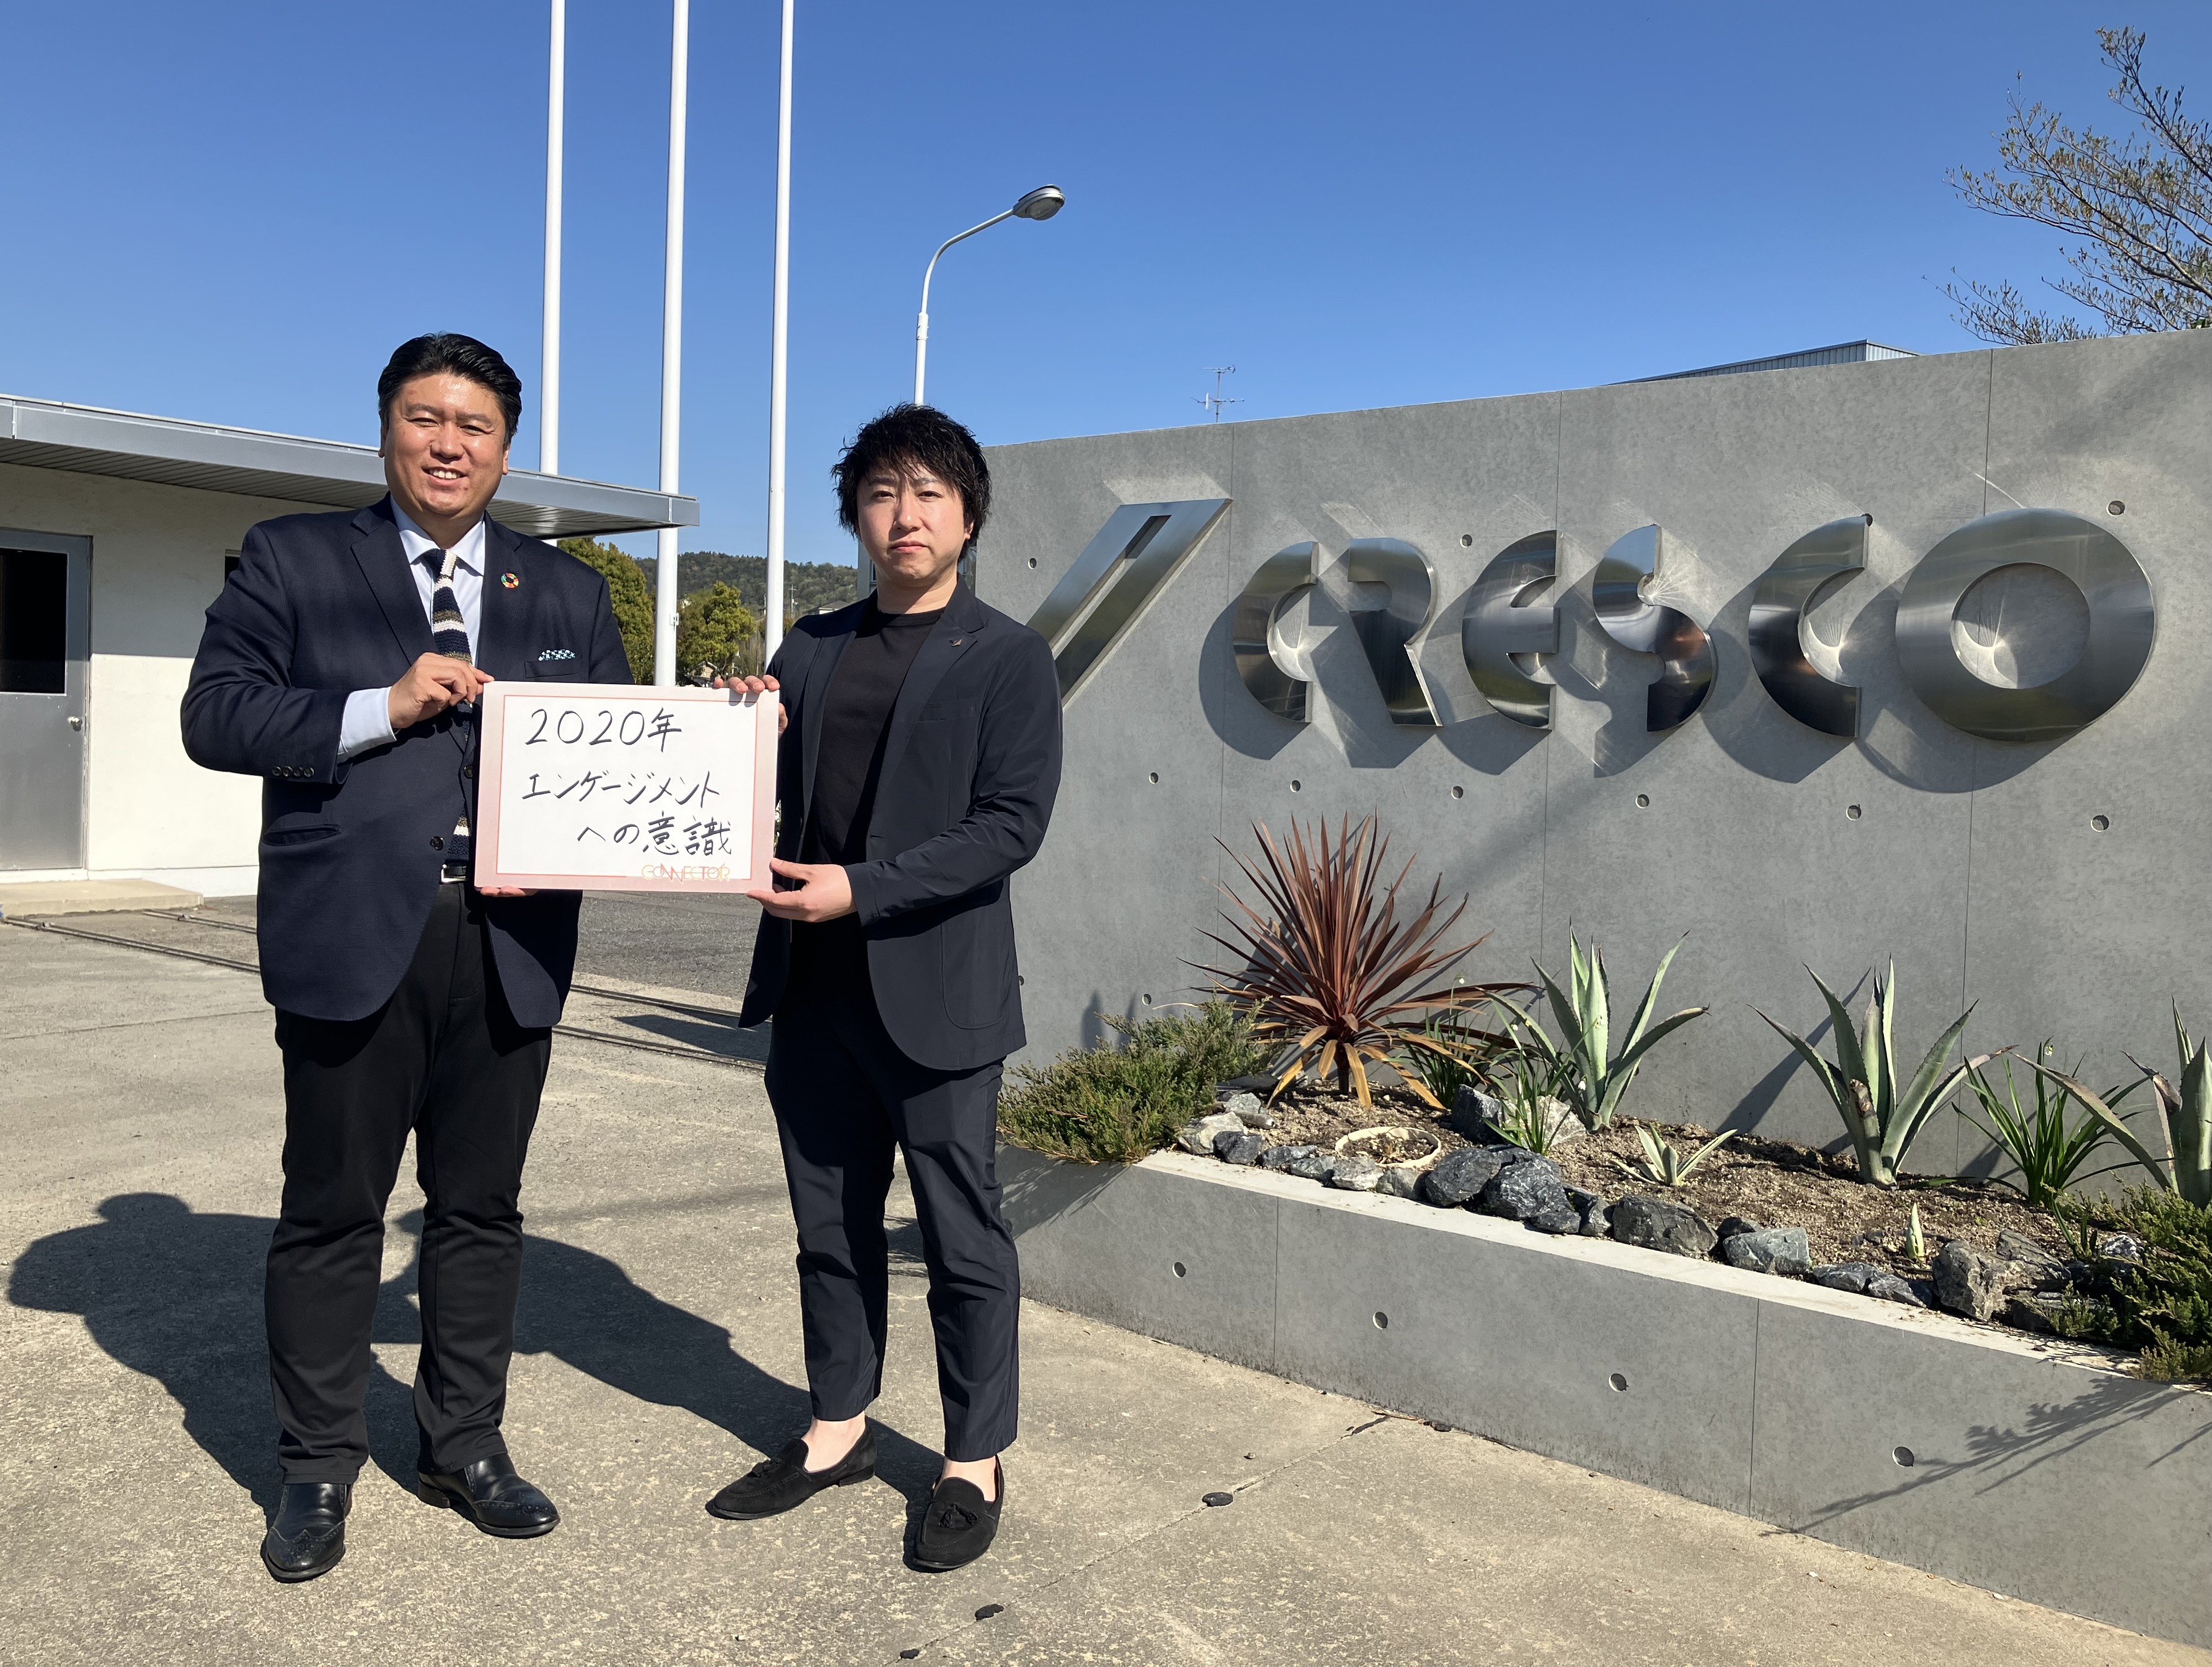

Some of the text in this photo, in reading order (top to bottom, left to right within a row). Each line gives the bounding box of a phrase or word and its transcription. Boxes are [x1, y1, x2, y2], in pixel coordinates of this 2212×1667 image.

[525, 708, 682, 753] 2020年
[522, 771, 720, 808] エンゲージメント
[577, 811, 731, 856] への意識
[641, 863, 730, 883] CONNECTOR
